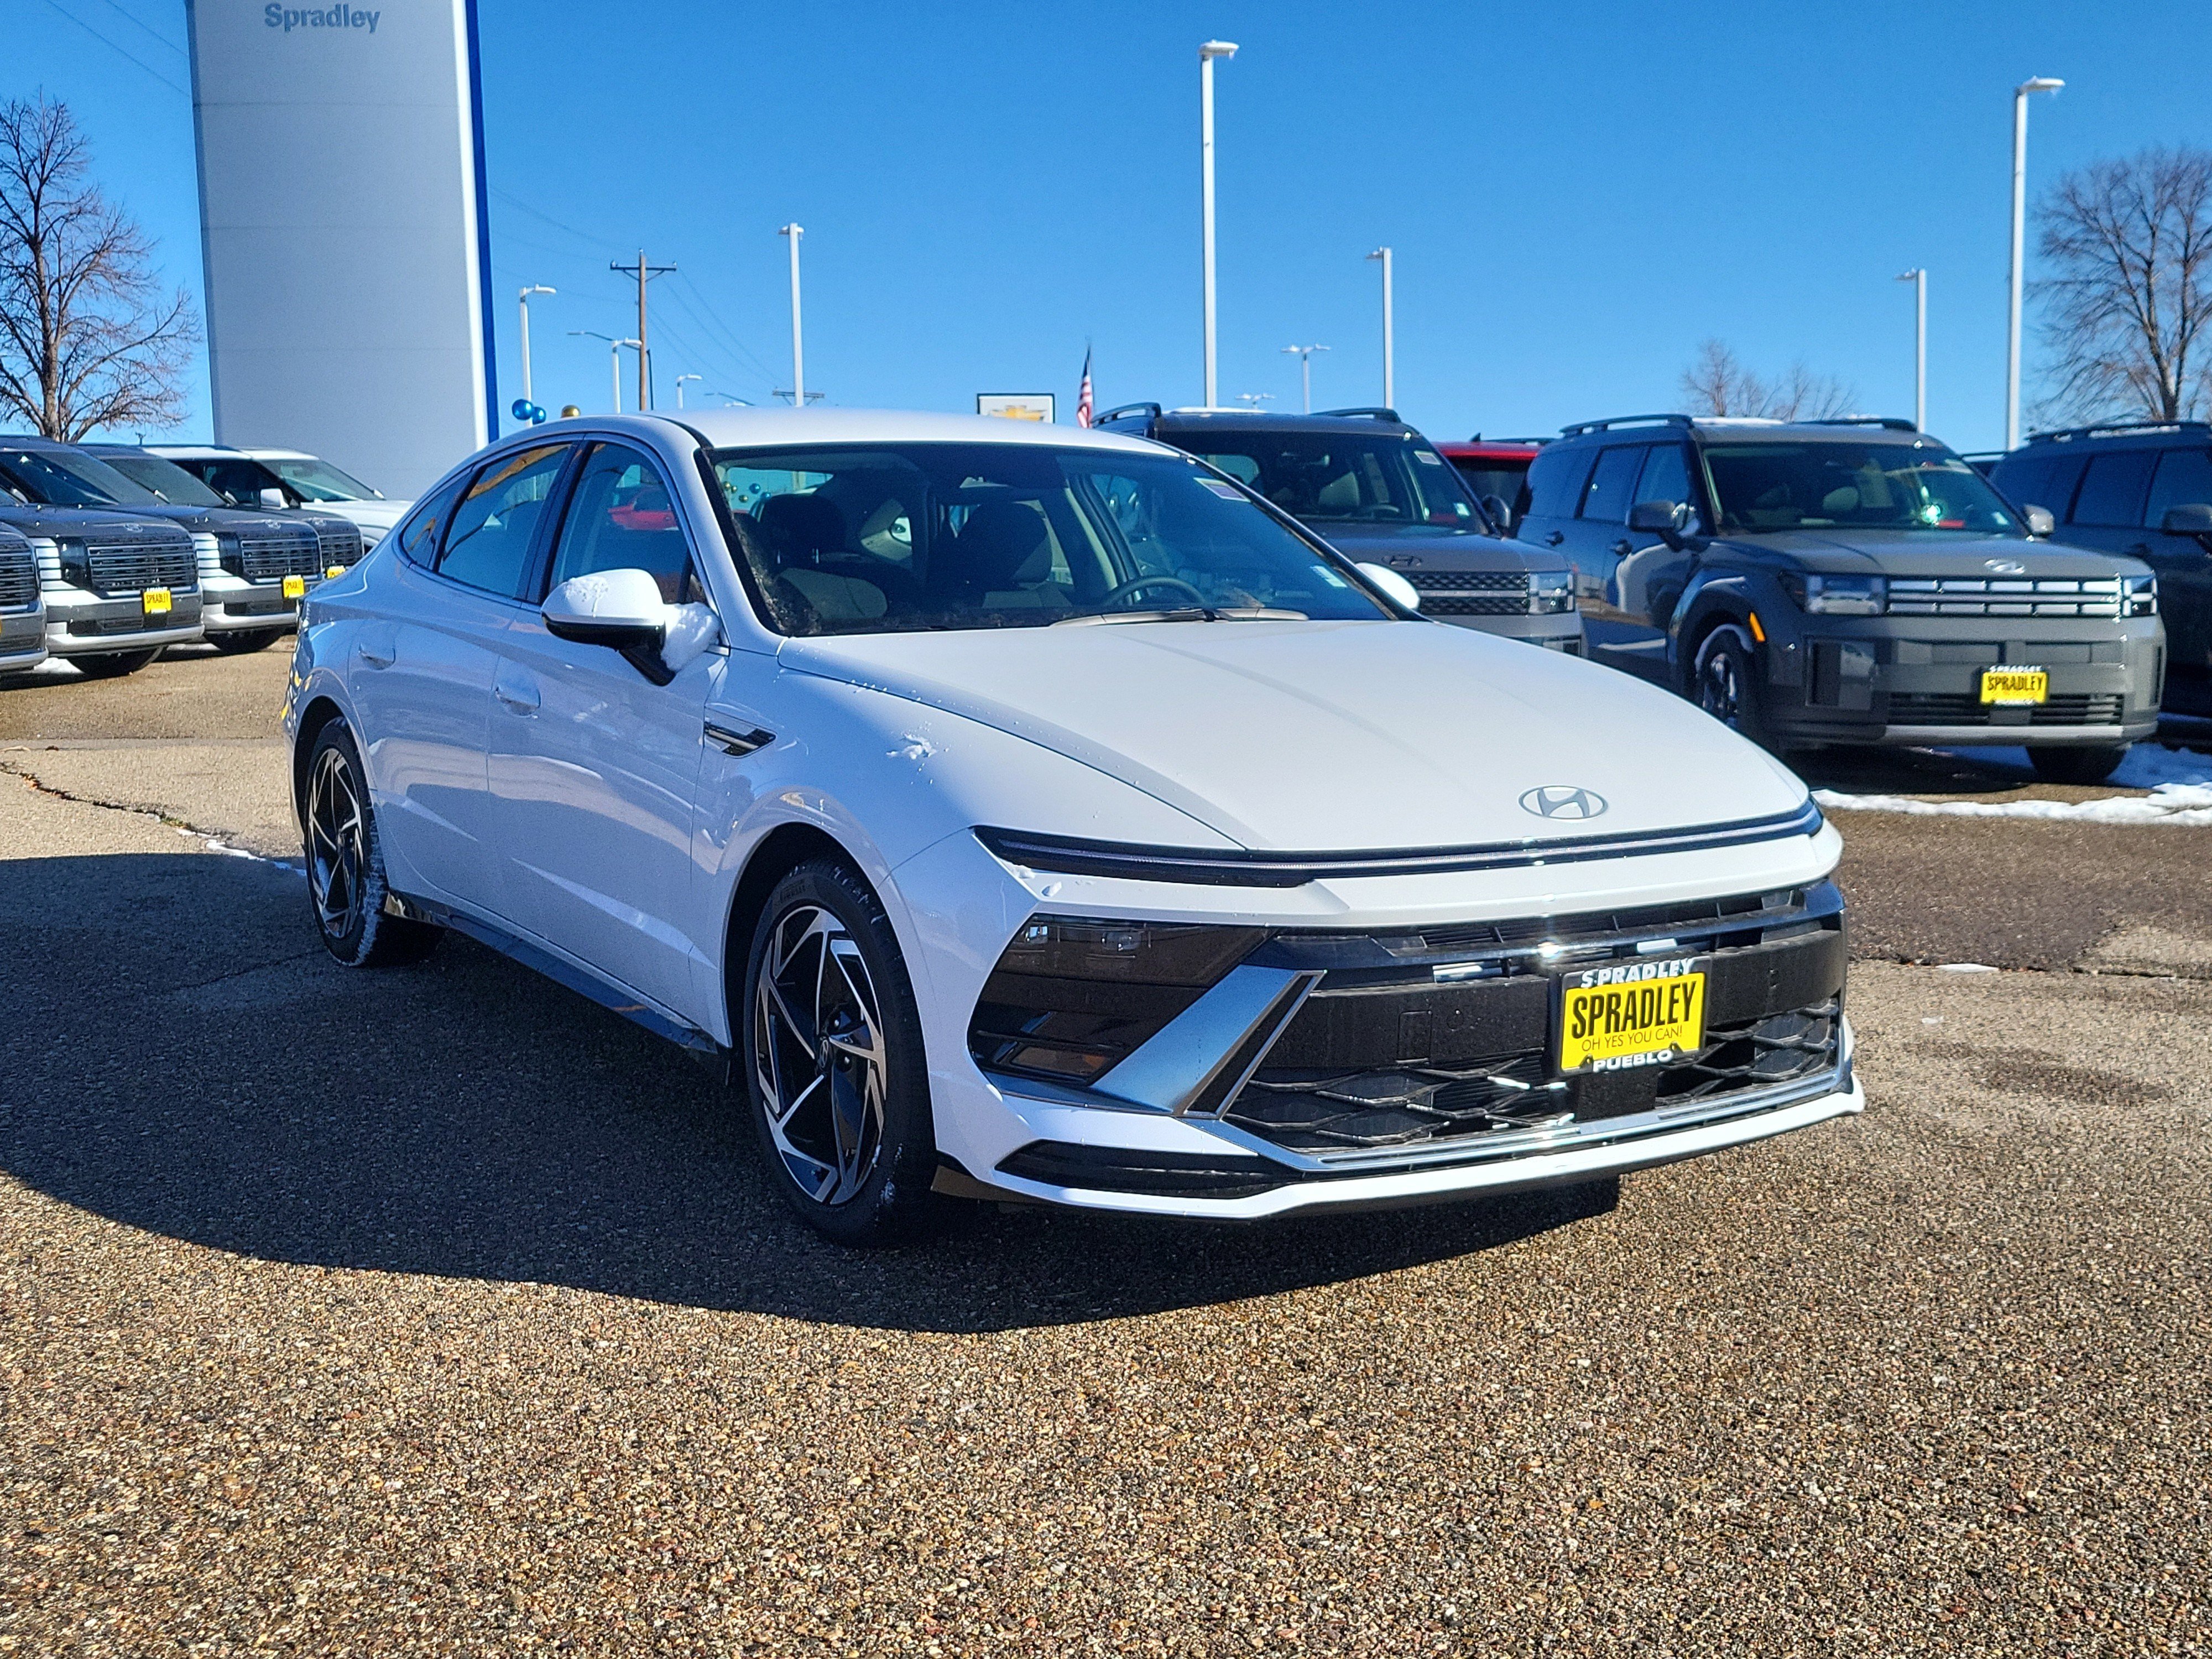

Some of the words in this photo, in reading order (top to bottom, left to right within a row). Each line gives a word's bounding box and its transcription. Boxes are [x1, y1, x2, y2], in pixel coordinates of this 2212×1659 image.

[264, 3, 380, 33] Spradley
[1987, 675, 2043, 691] SPRADLEY
[1580, 958, 1693, 988] SPRADLEY
[1572, 980, 1697, 1040] SPRADLEY
[1582, 1037, 1600, 1052] OH
[1604, 1034, 1623, 1048] YES
[1627, 1030, 1652, 1046] YOU
[1655, 1025, 1682, 1041] CAN!
[1593, 1049, 1673, 1072] PUEBLO
